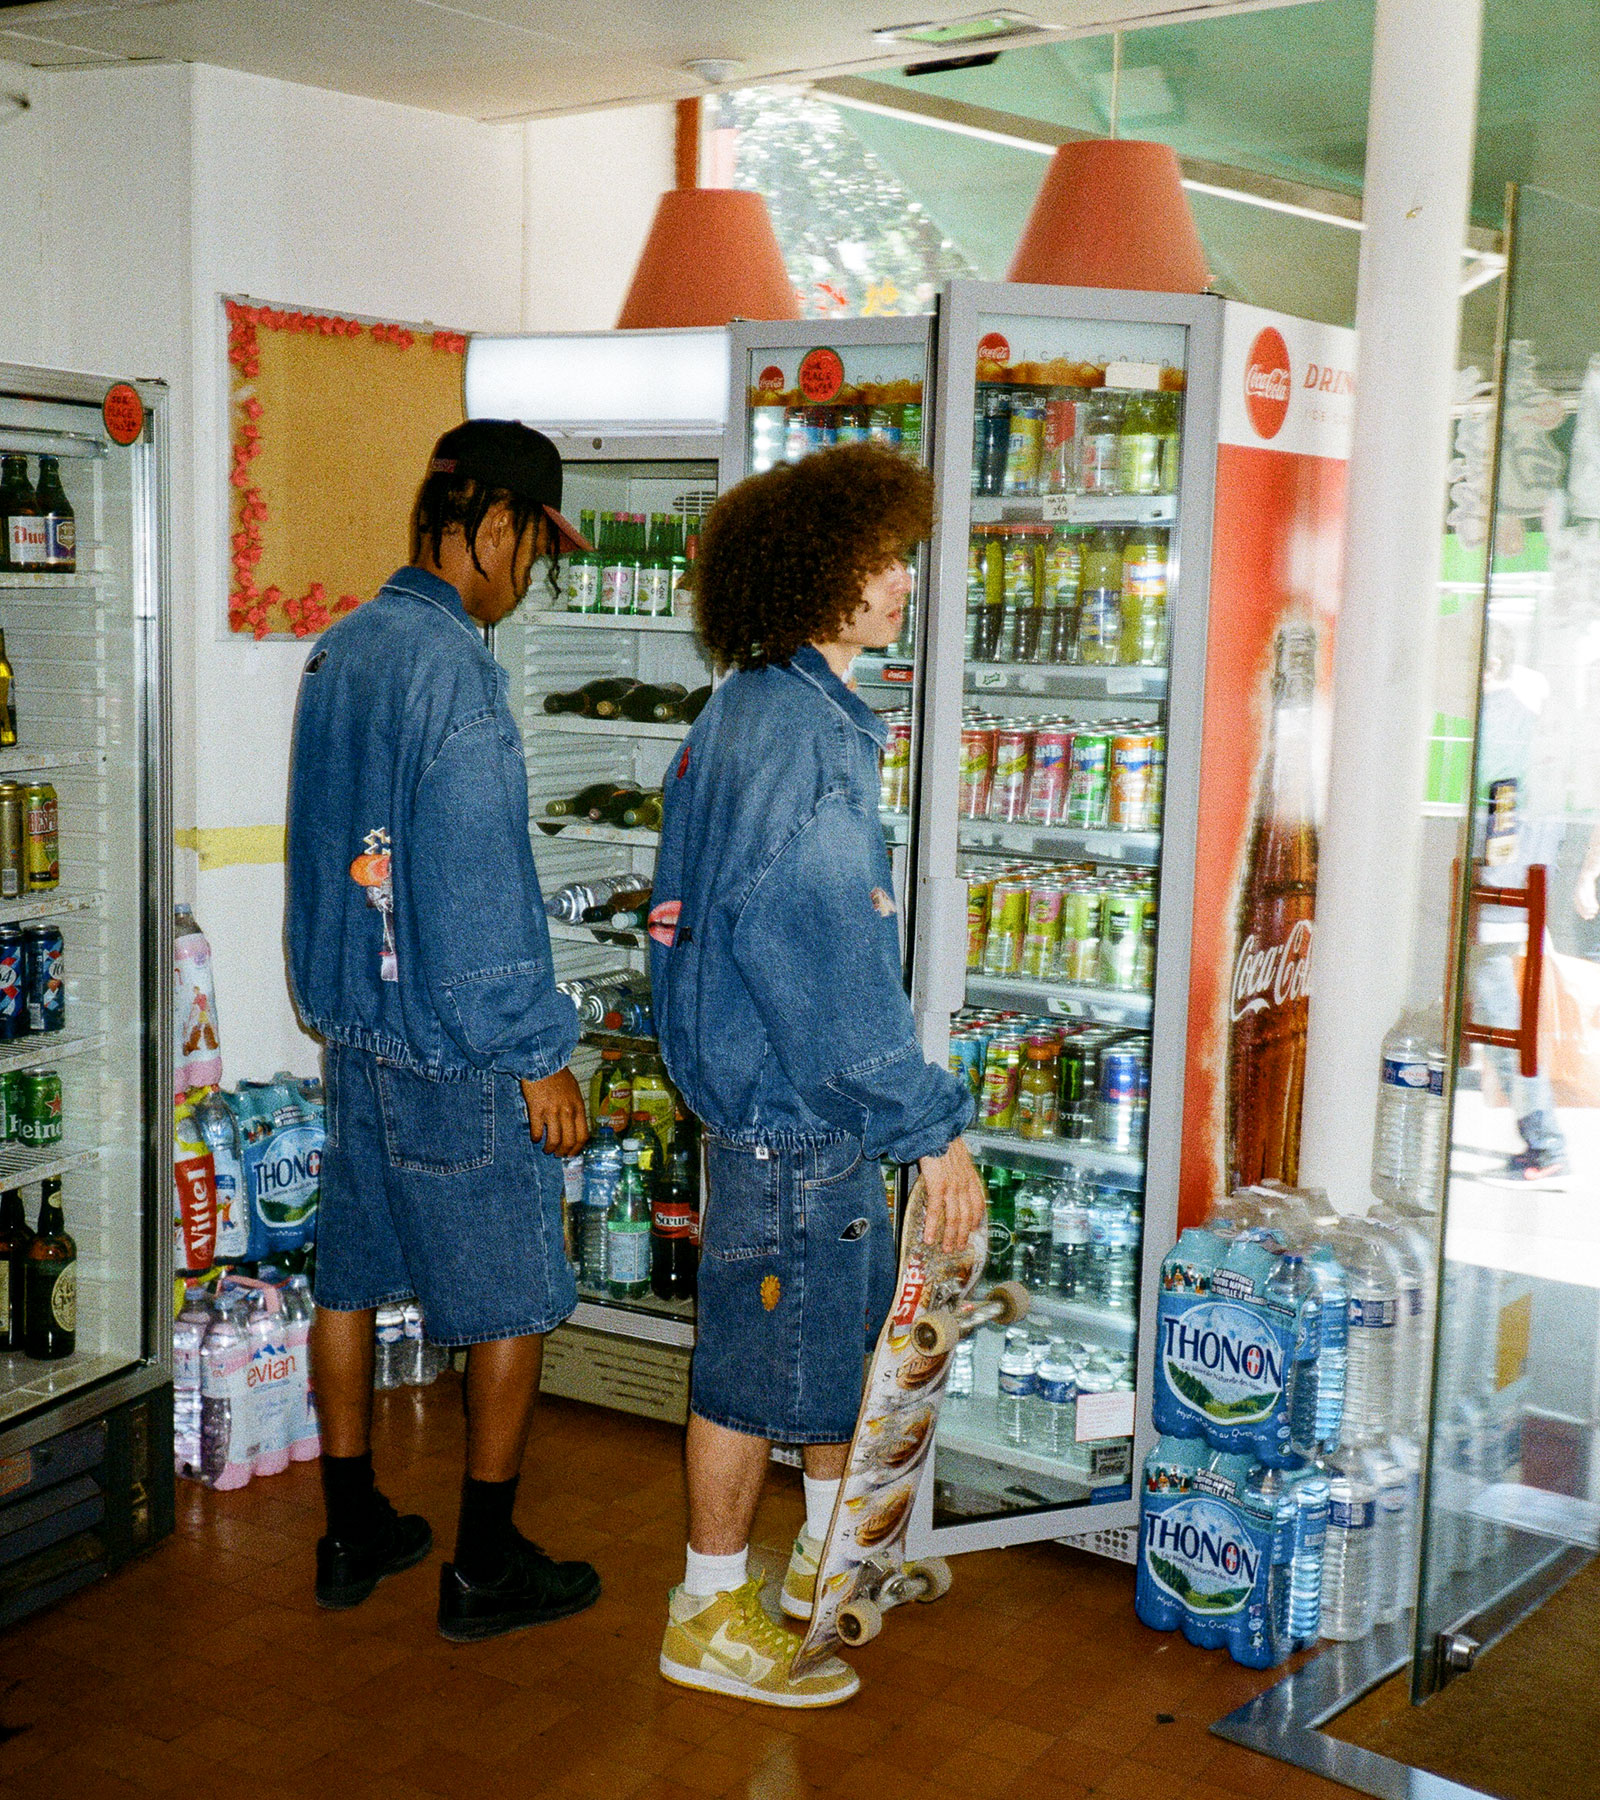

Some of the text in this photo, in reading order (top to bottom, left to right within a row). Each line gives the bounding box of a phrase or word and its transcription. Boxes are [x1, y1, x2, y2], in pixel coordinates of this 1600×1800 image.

[186, 1167, 212, 1251] Vittel
[246, 1354, 296, 1388] evian
[1163, 1317, 1282, 1389] THONON
[1146, 1512, 1260, 1584] THONON
